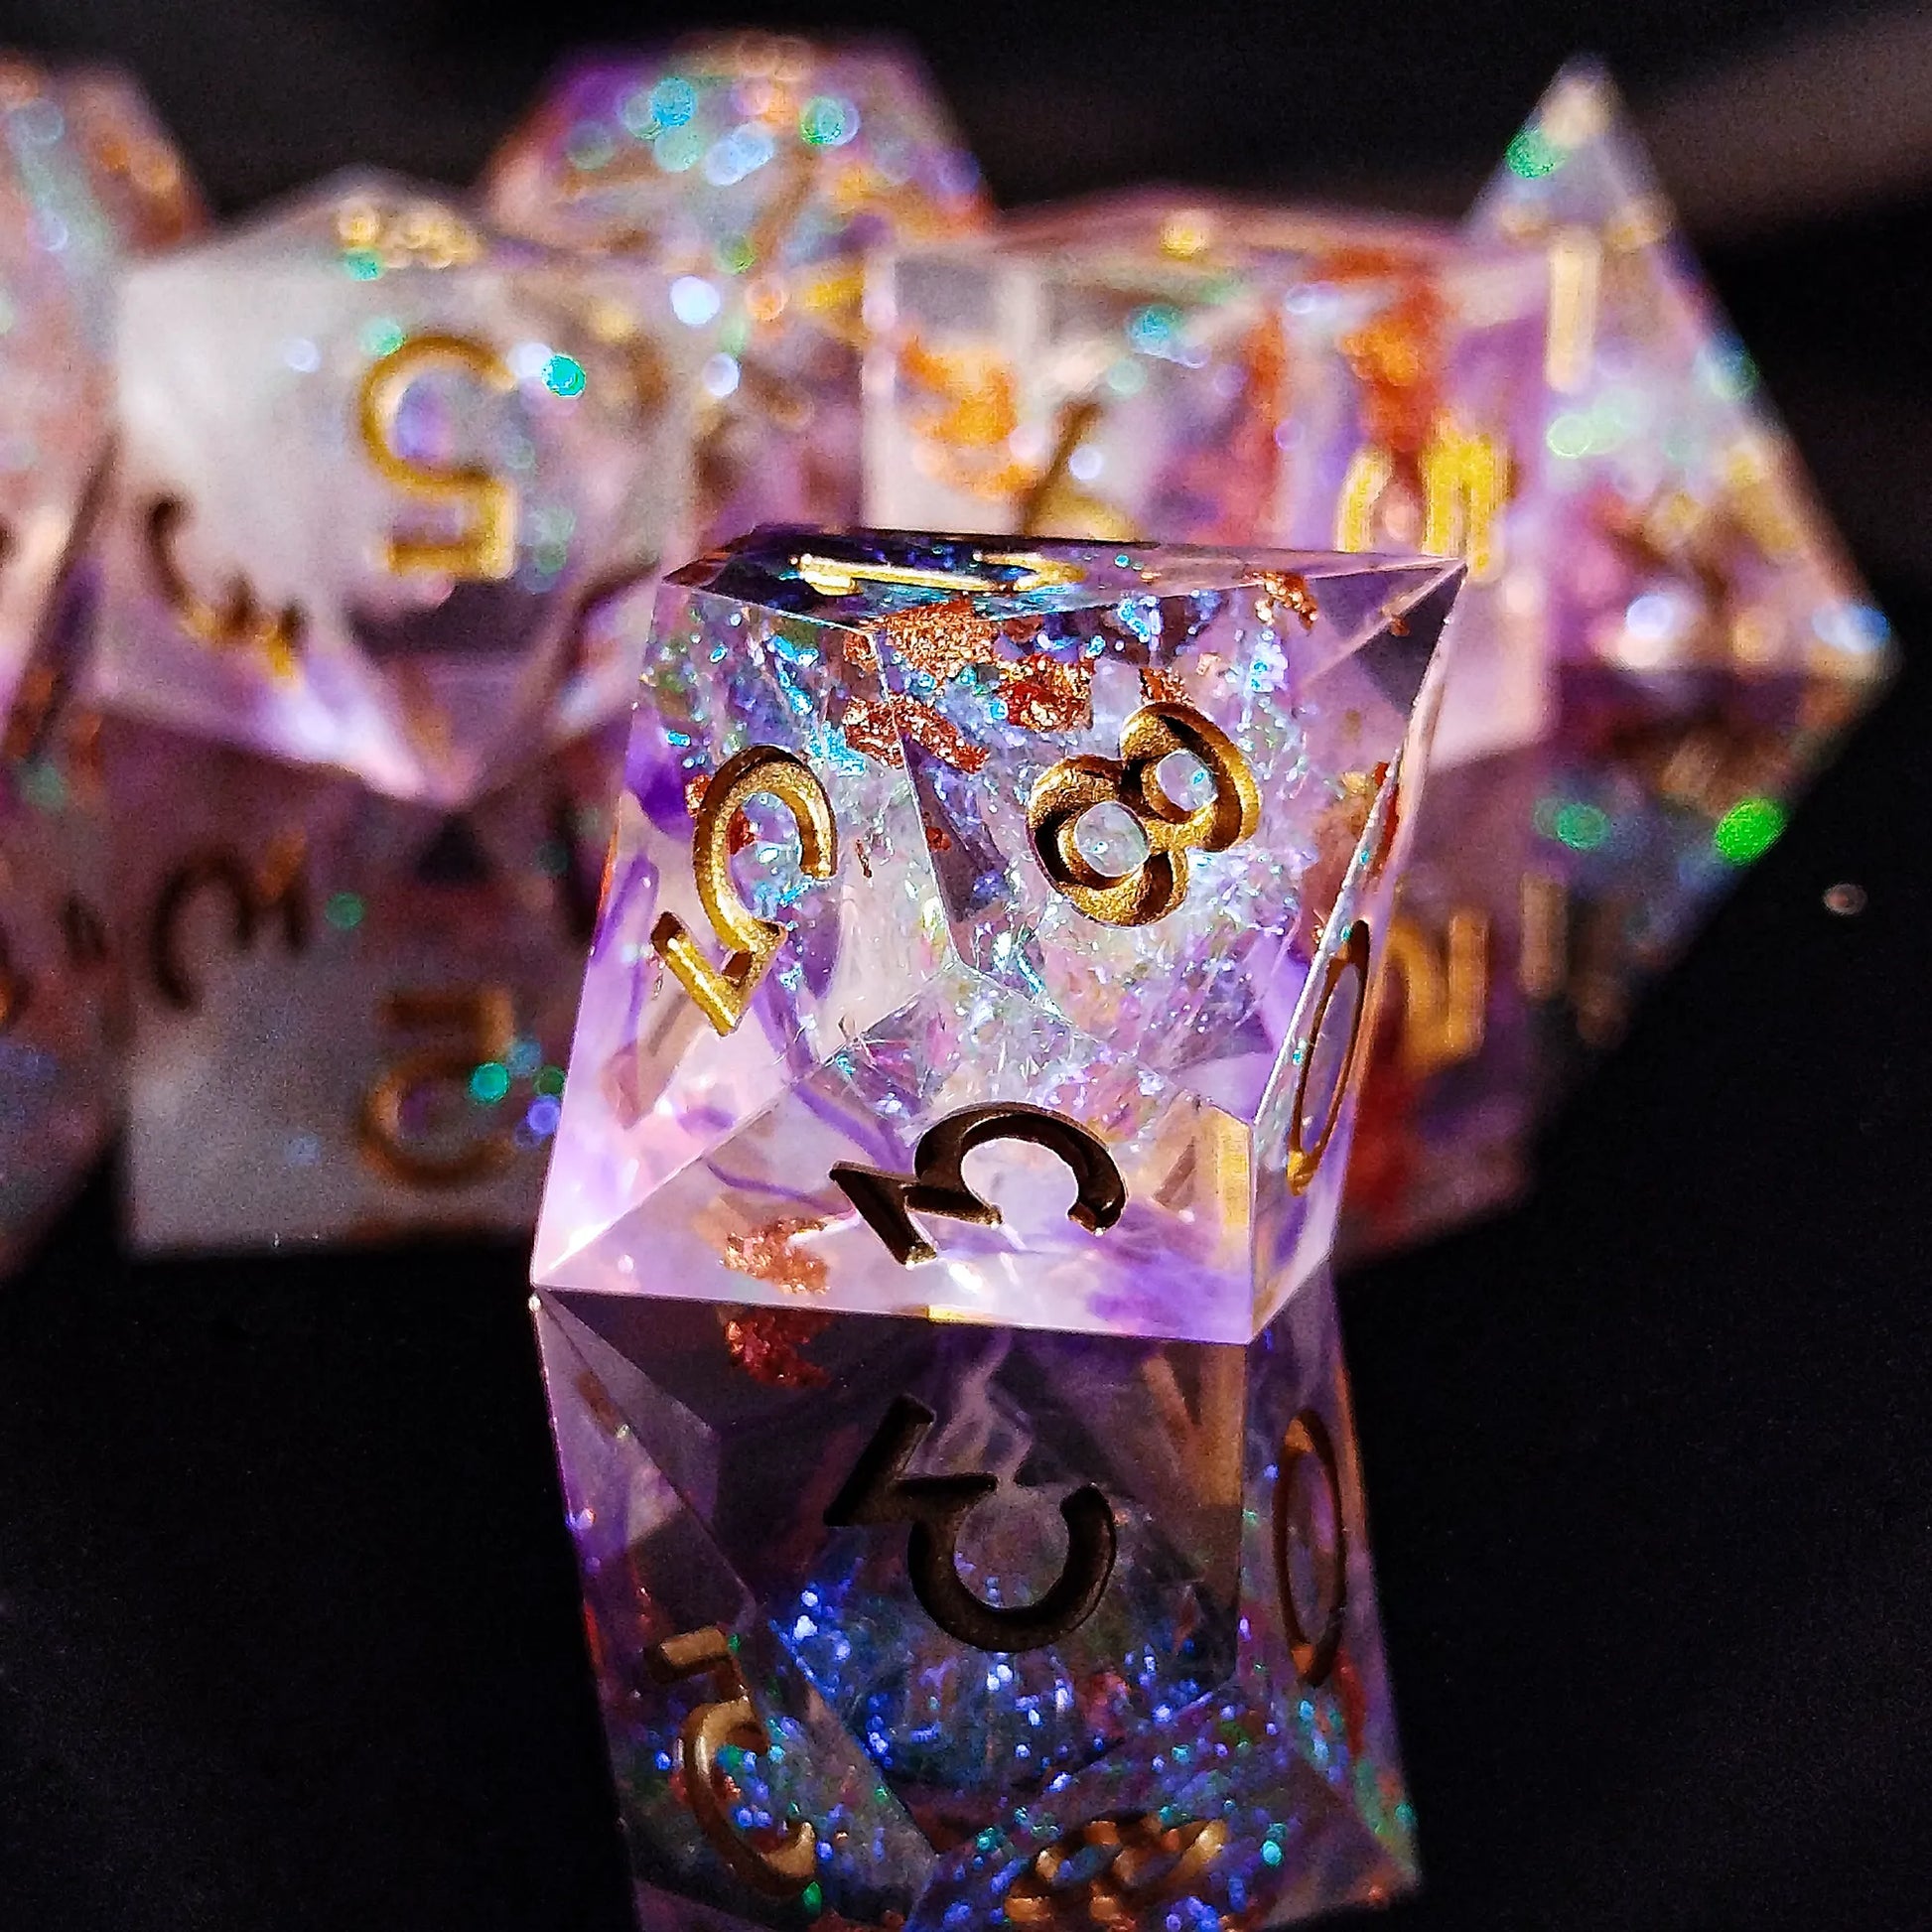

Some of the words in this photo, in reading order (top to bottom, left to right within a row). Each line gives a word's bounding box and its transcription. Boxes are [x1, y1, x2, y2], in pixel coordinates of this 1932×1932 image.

[359, 335, 520, 582] 5
[651, 745, 836, 1038] 5
[1029, 702, 1263, 925] 8
